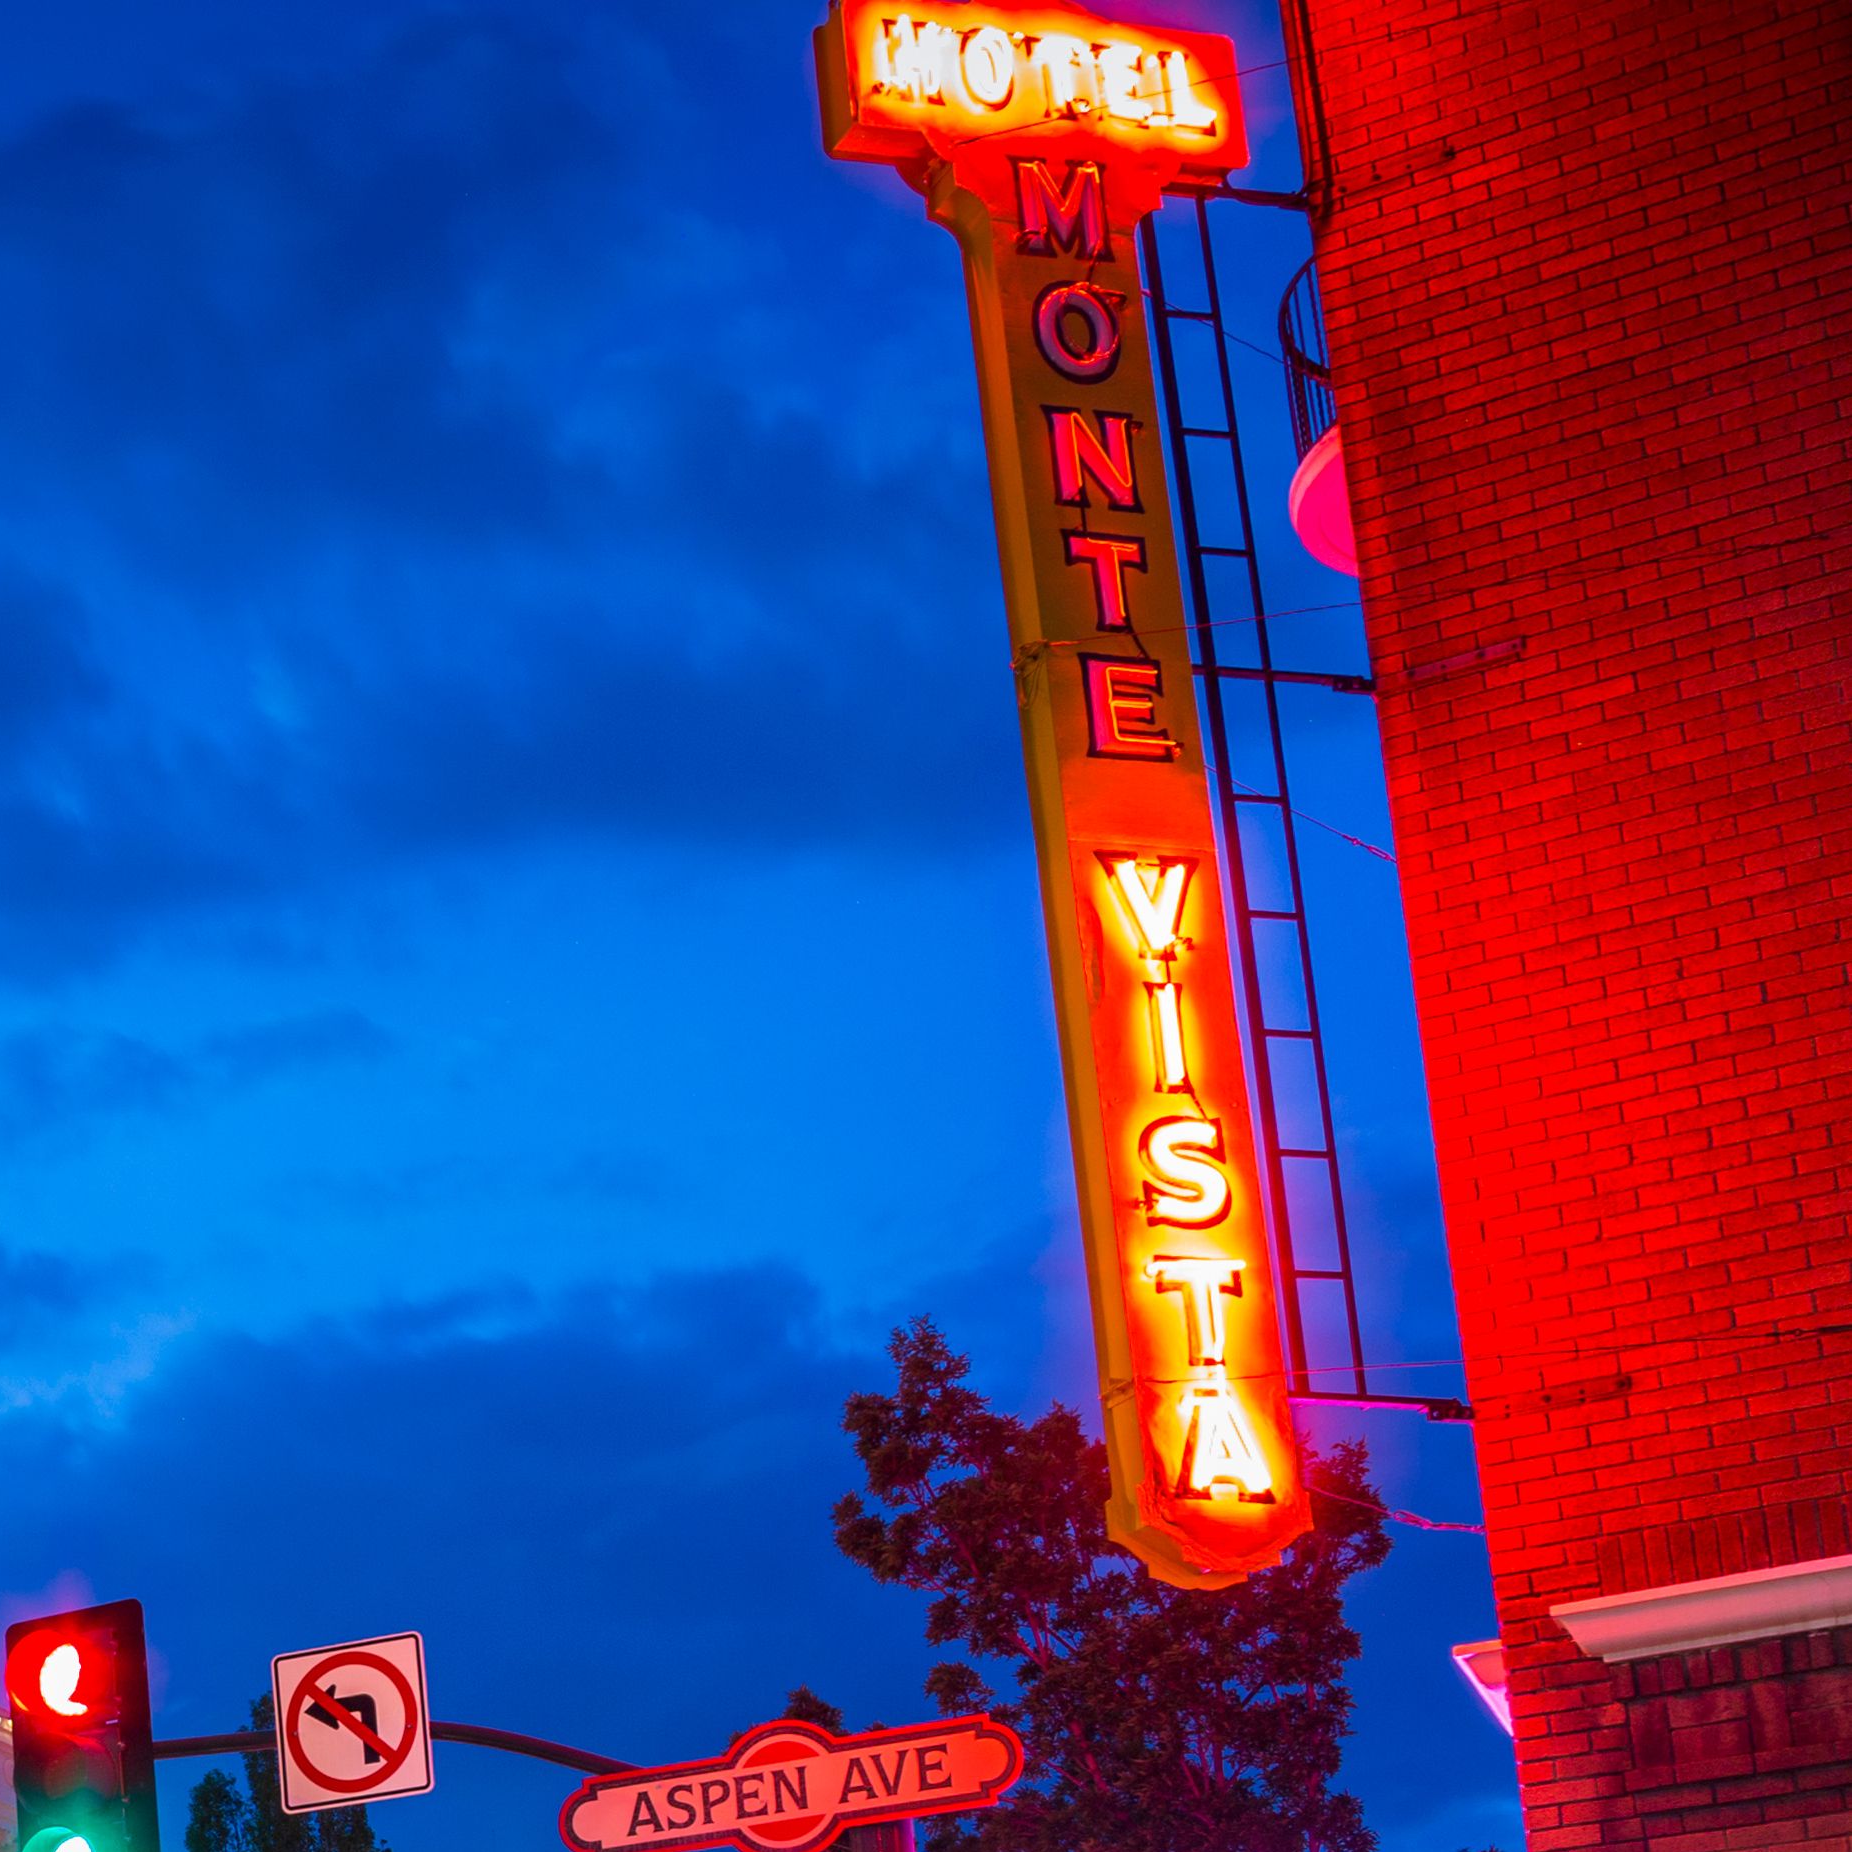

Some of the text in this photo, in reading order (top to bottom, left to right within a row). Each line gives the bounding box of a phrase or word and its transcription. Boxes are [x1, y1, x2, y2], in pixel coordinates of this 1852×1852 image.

[875, 14, 1217, 137] HOTEL
[1011, 154, 1183, 763] MONTE
[1094, 850, 1276, 1504] VISTA
[627, 1742, 953, 1837] ASPEN AVE
